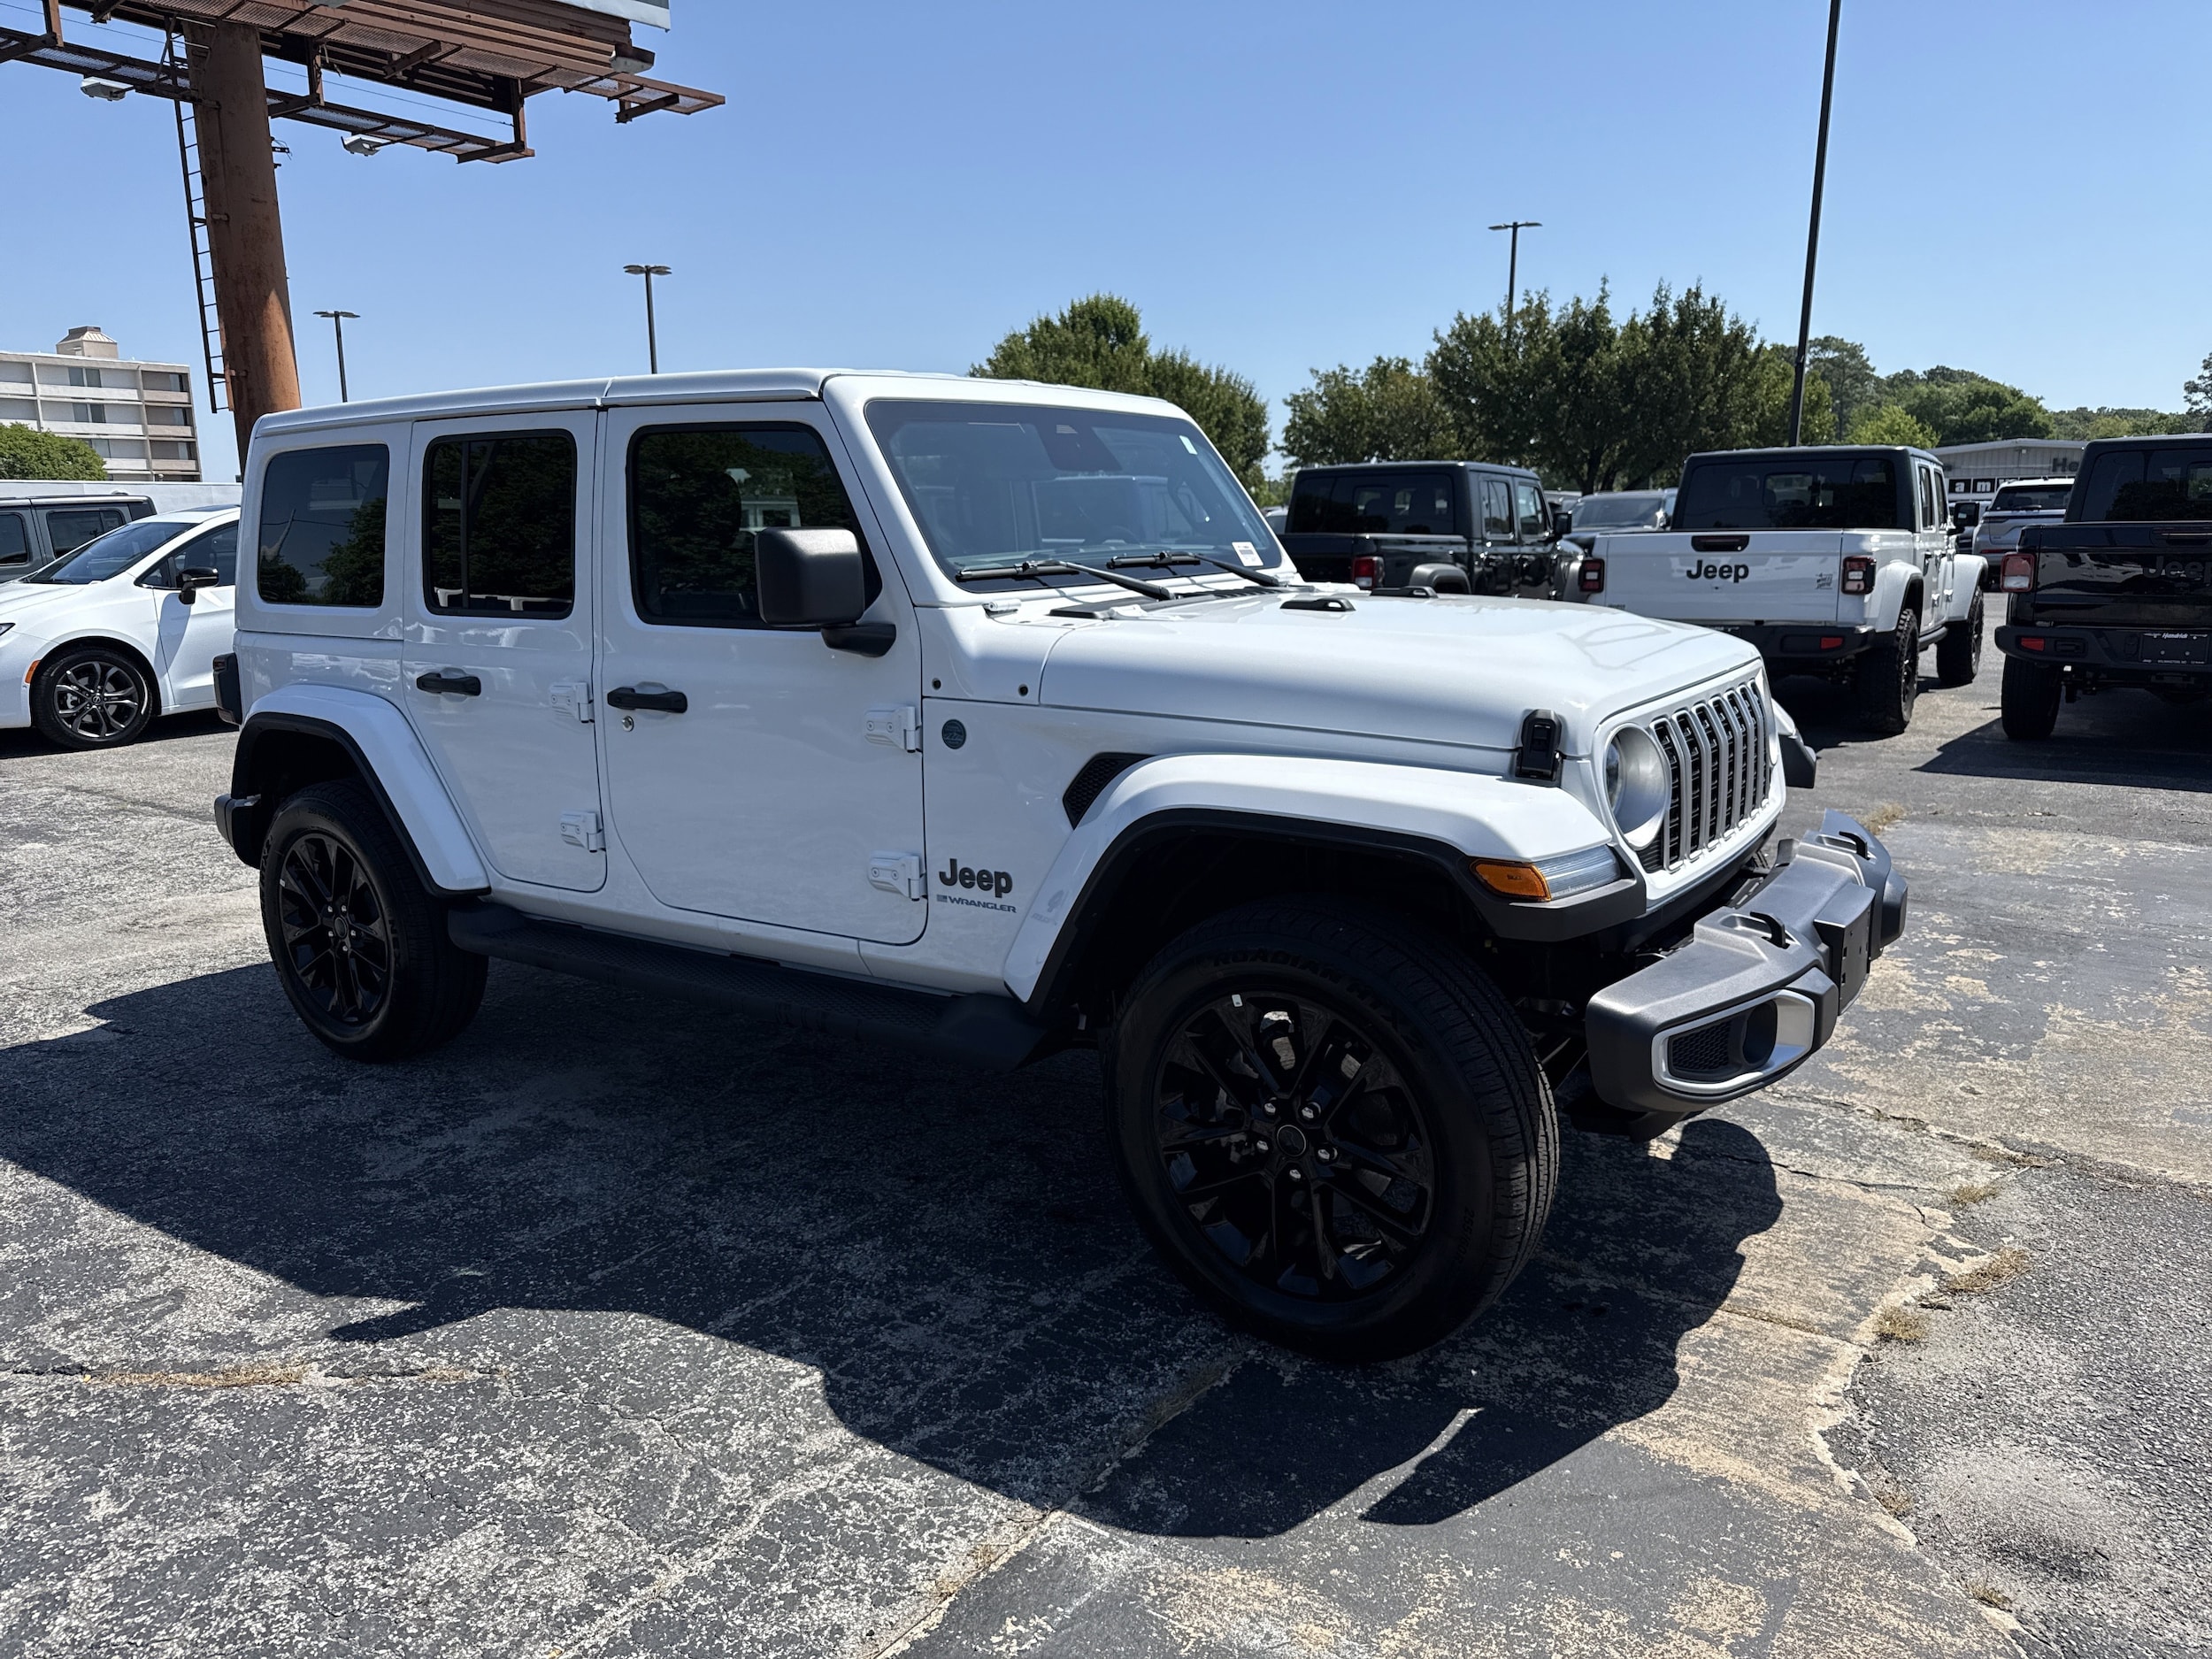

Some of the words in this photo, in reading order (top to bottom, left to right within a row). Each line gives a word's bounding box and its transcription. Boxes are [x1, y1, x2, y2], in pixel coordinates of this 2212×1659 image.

[1686, 559, 1749, 583] Jeep
[939, 858, 1013, 898] Jeep
[949, 895, 1018, 913] WRANGLER
